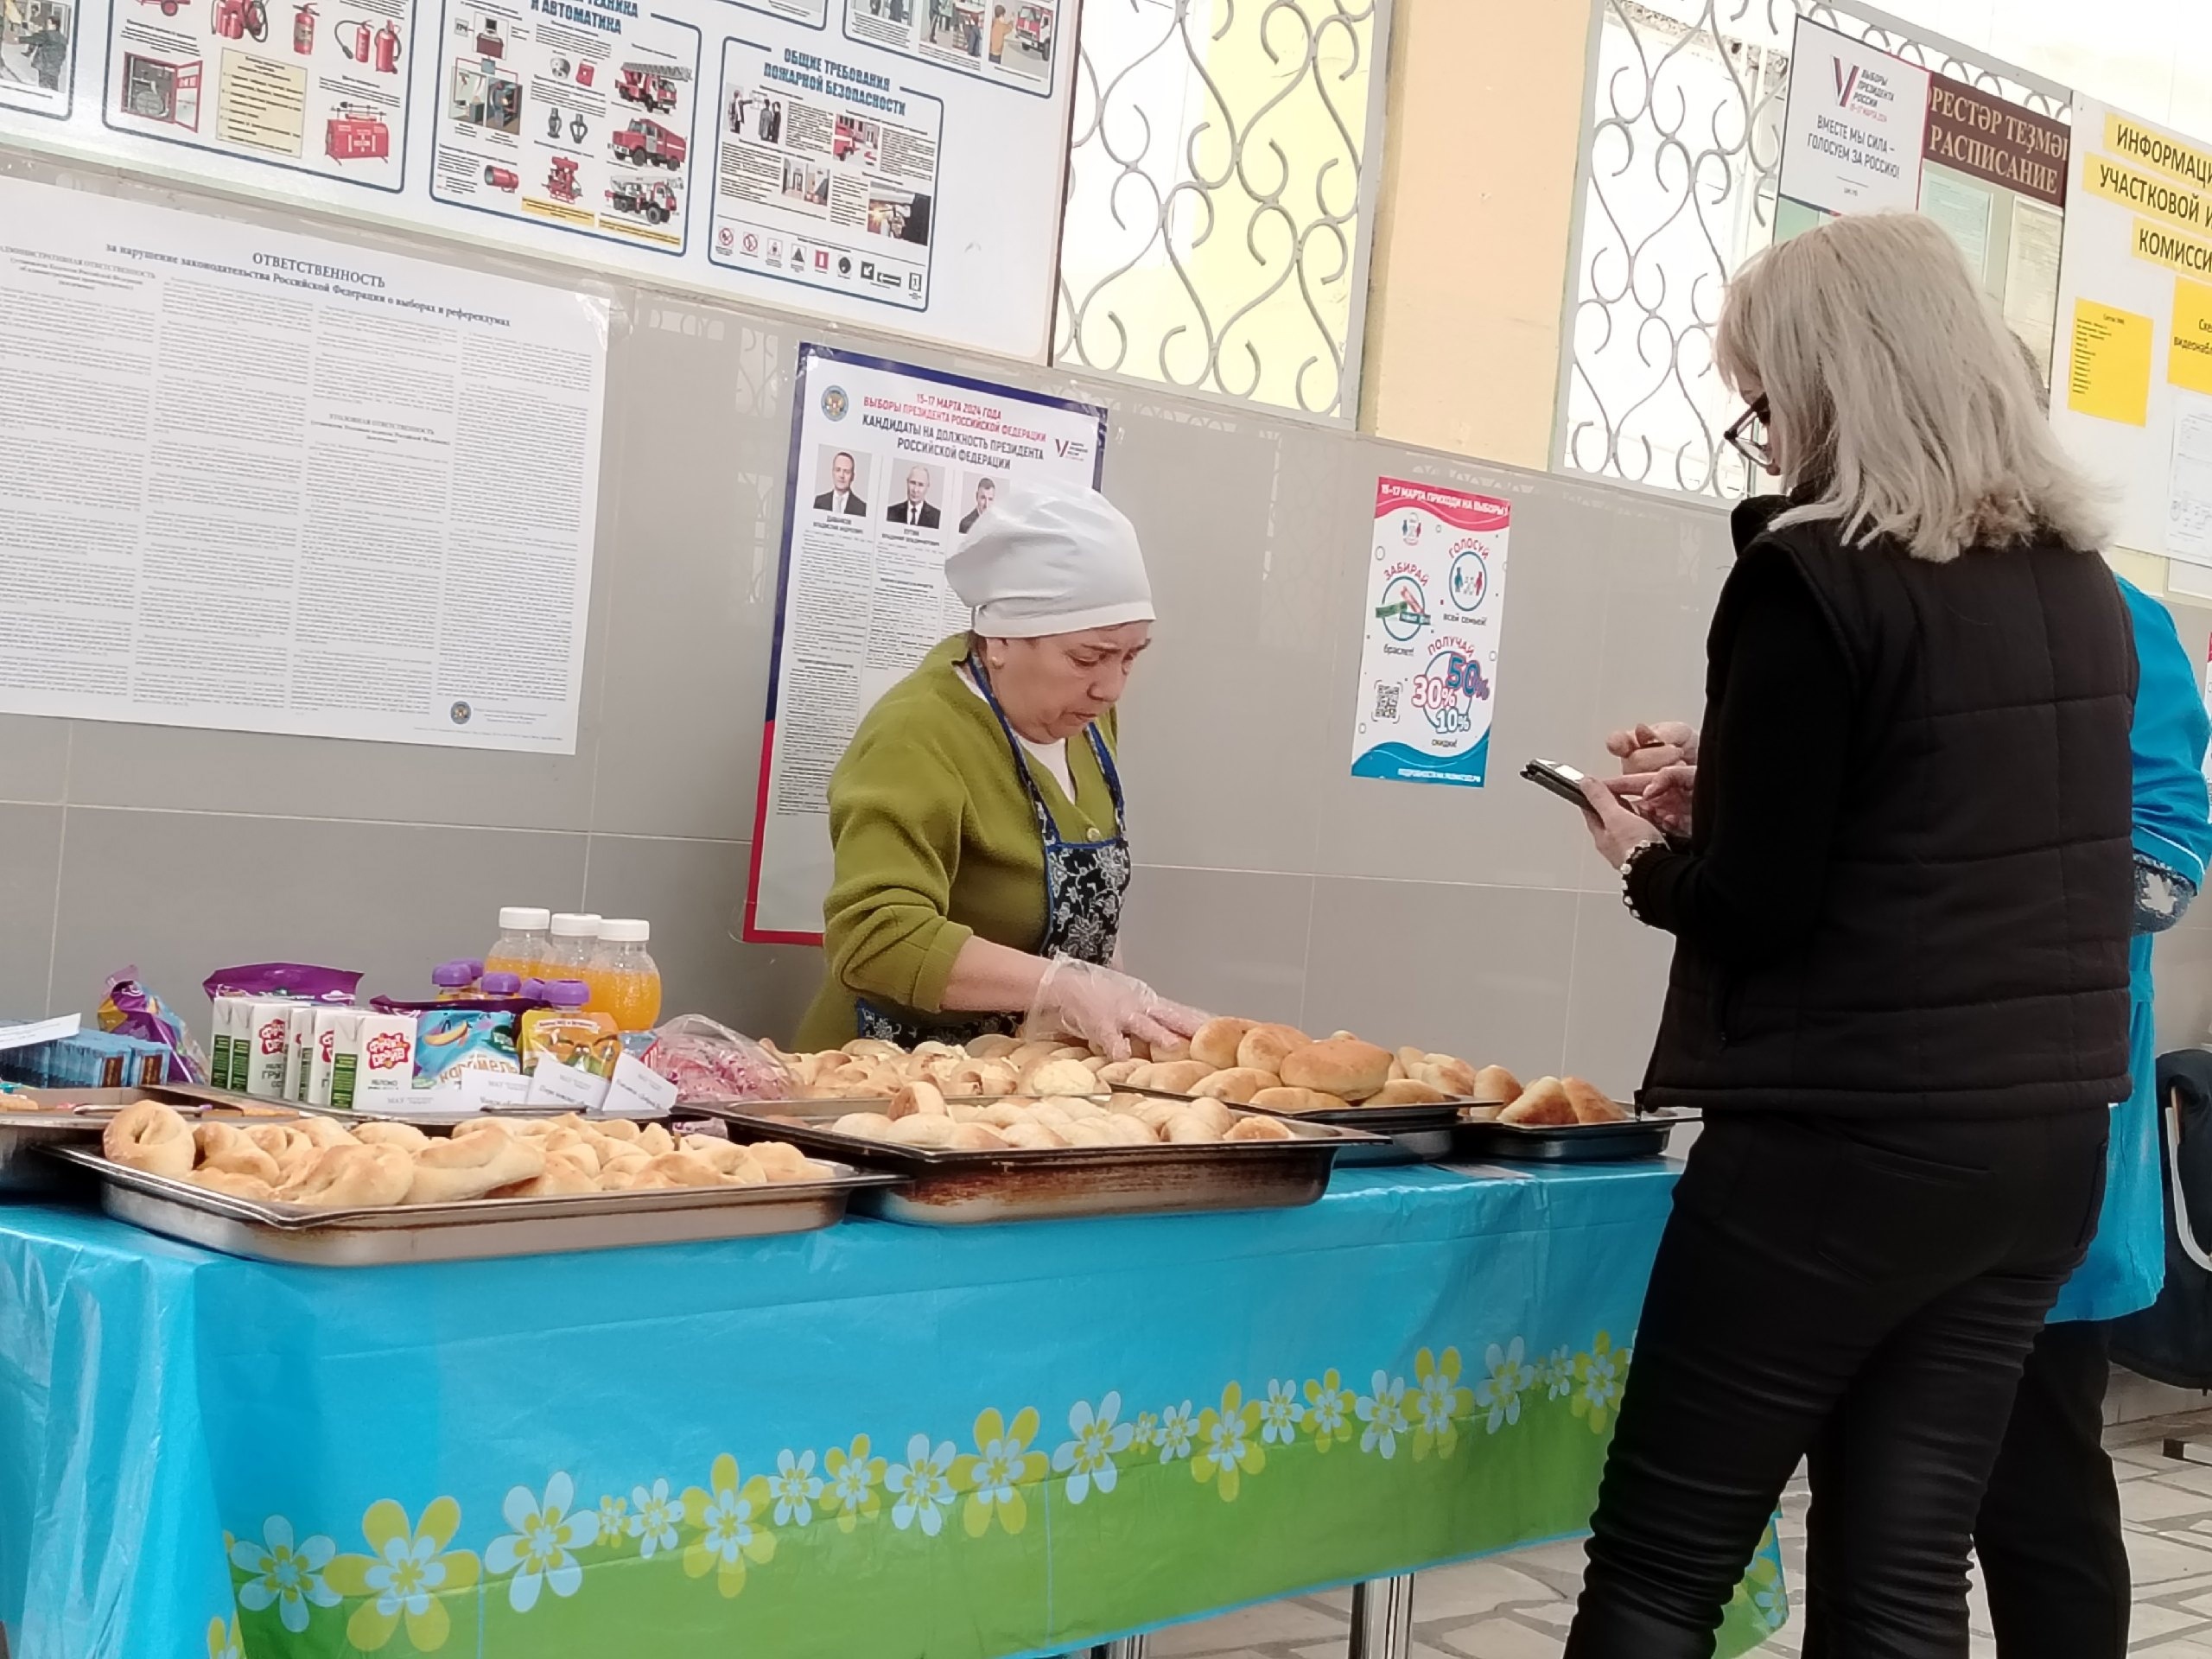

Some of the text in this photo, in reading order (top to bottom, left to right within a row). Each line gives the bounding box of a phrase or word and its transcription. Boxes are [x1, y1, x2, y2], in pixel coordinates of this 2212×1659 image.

[541, 0, 622, 35] АВТОМАТИКА
[763, 62, 906, 116] ПОЖАРНОЙ БЕЗОПАСНОСТИ
[784, 48, 891, 92] ОБЩИЕ ТРЕБОВАНИЯ
[1817, 115, 1847, 139] ВМЕСТЕ
[1849, 127, 1866, 145] МЫ
[1867, 134, 1887, 153] СИЛА
[1808, 133, 1900, 179] ГОЛОСУЕМ ЗА РОССИЮ!
[1929, 124, 2058, 194] РАСПИСАНИЕ
[2100, 164, 2200, 223] УЧАСТКОВОЙ
[2139, 228, 2212, 273] КОМИССИ
[105, 244, 117, 252] за
[120, 246, 178, 264] нарушение
[181, 258, 270, 281] законодательства
[273, 274, 330, 292] Российской
[332, 284, 385, 302] Федерации
[396, 296, 435, 313] выборах
[445, 308, 511, 327] референдумах
[252, 252, 386, 288] ОТВЕТСТВЕННОСТЬ
[863, 396, 1046, 442] ВЫБОРЫ ПРЕЗИДЕНТА РОССИЙСКОЙ ФЕДЕРАЦИИ
[937, 397, 961, 411] МАРТА
[982, 407, 1001, 419] ГОДА
[862, 414, 1044, 460] КАНДИДАТЫ НА ДОЛЖНОСТЬ ПРЕЗИДЕНТА
[897, 437, 1011, 470] РОССИЙСКОЙ ФЕДЕРАЦИИ
[1401, 488, 1425, 500] МАРТА
[1427, 493, 1461, 508] ПРИХОДИ
[1462, 499, 1472, 509] НА
[1449, 537, 1490, 559] ГОЛОСУЙ
[1383, 562, 1430, 587] ЗАБИРАЙ
[1427, 636, 1475, 658] ПОЛУЧАЙ
[1411, 674, 1458, 709] 30%
[1446, 652, 1491, 701] 50%
[1435, 707, 1471, 734] 10%
